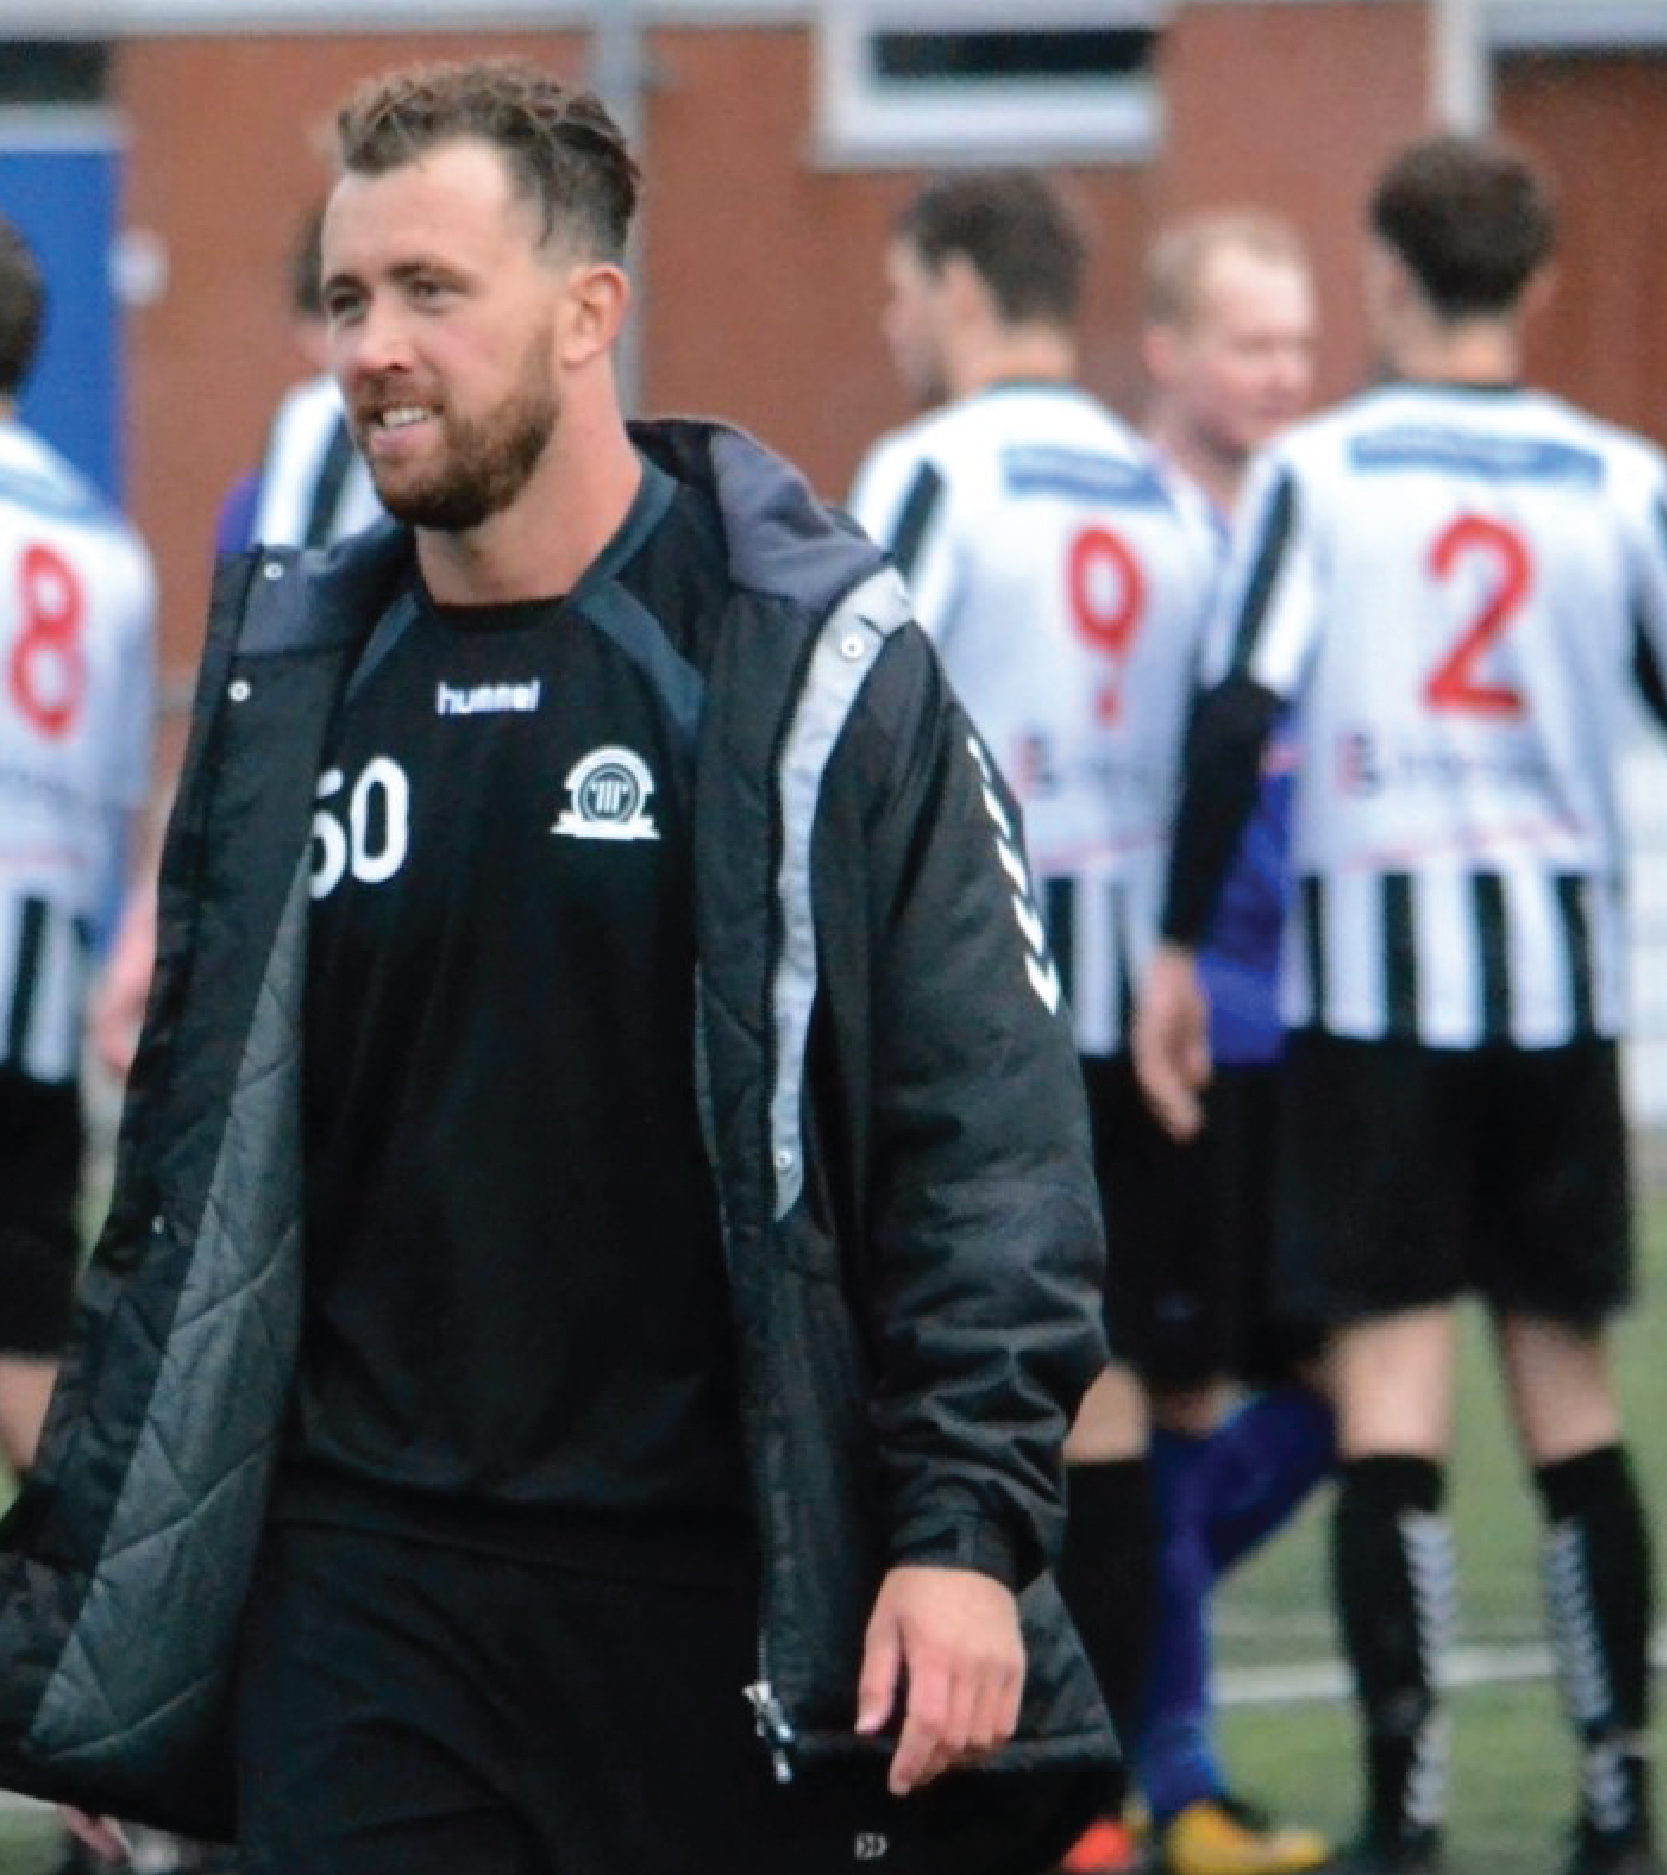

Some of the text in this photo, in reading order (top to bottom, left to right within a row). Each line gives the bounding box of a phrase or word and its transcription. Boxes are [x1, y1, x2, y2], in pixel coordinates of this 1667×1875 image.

[8, 542, 84, 740] 8
[437, 679, 540, 715] hummel
[1064, 522, 1146, 724] 9
[1424, 512, 1534, 718] 2
